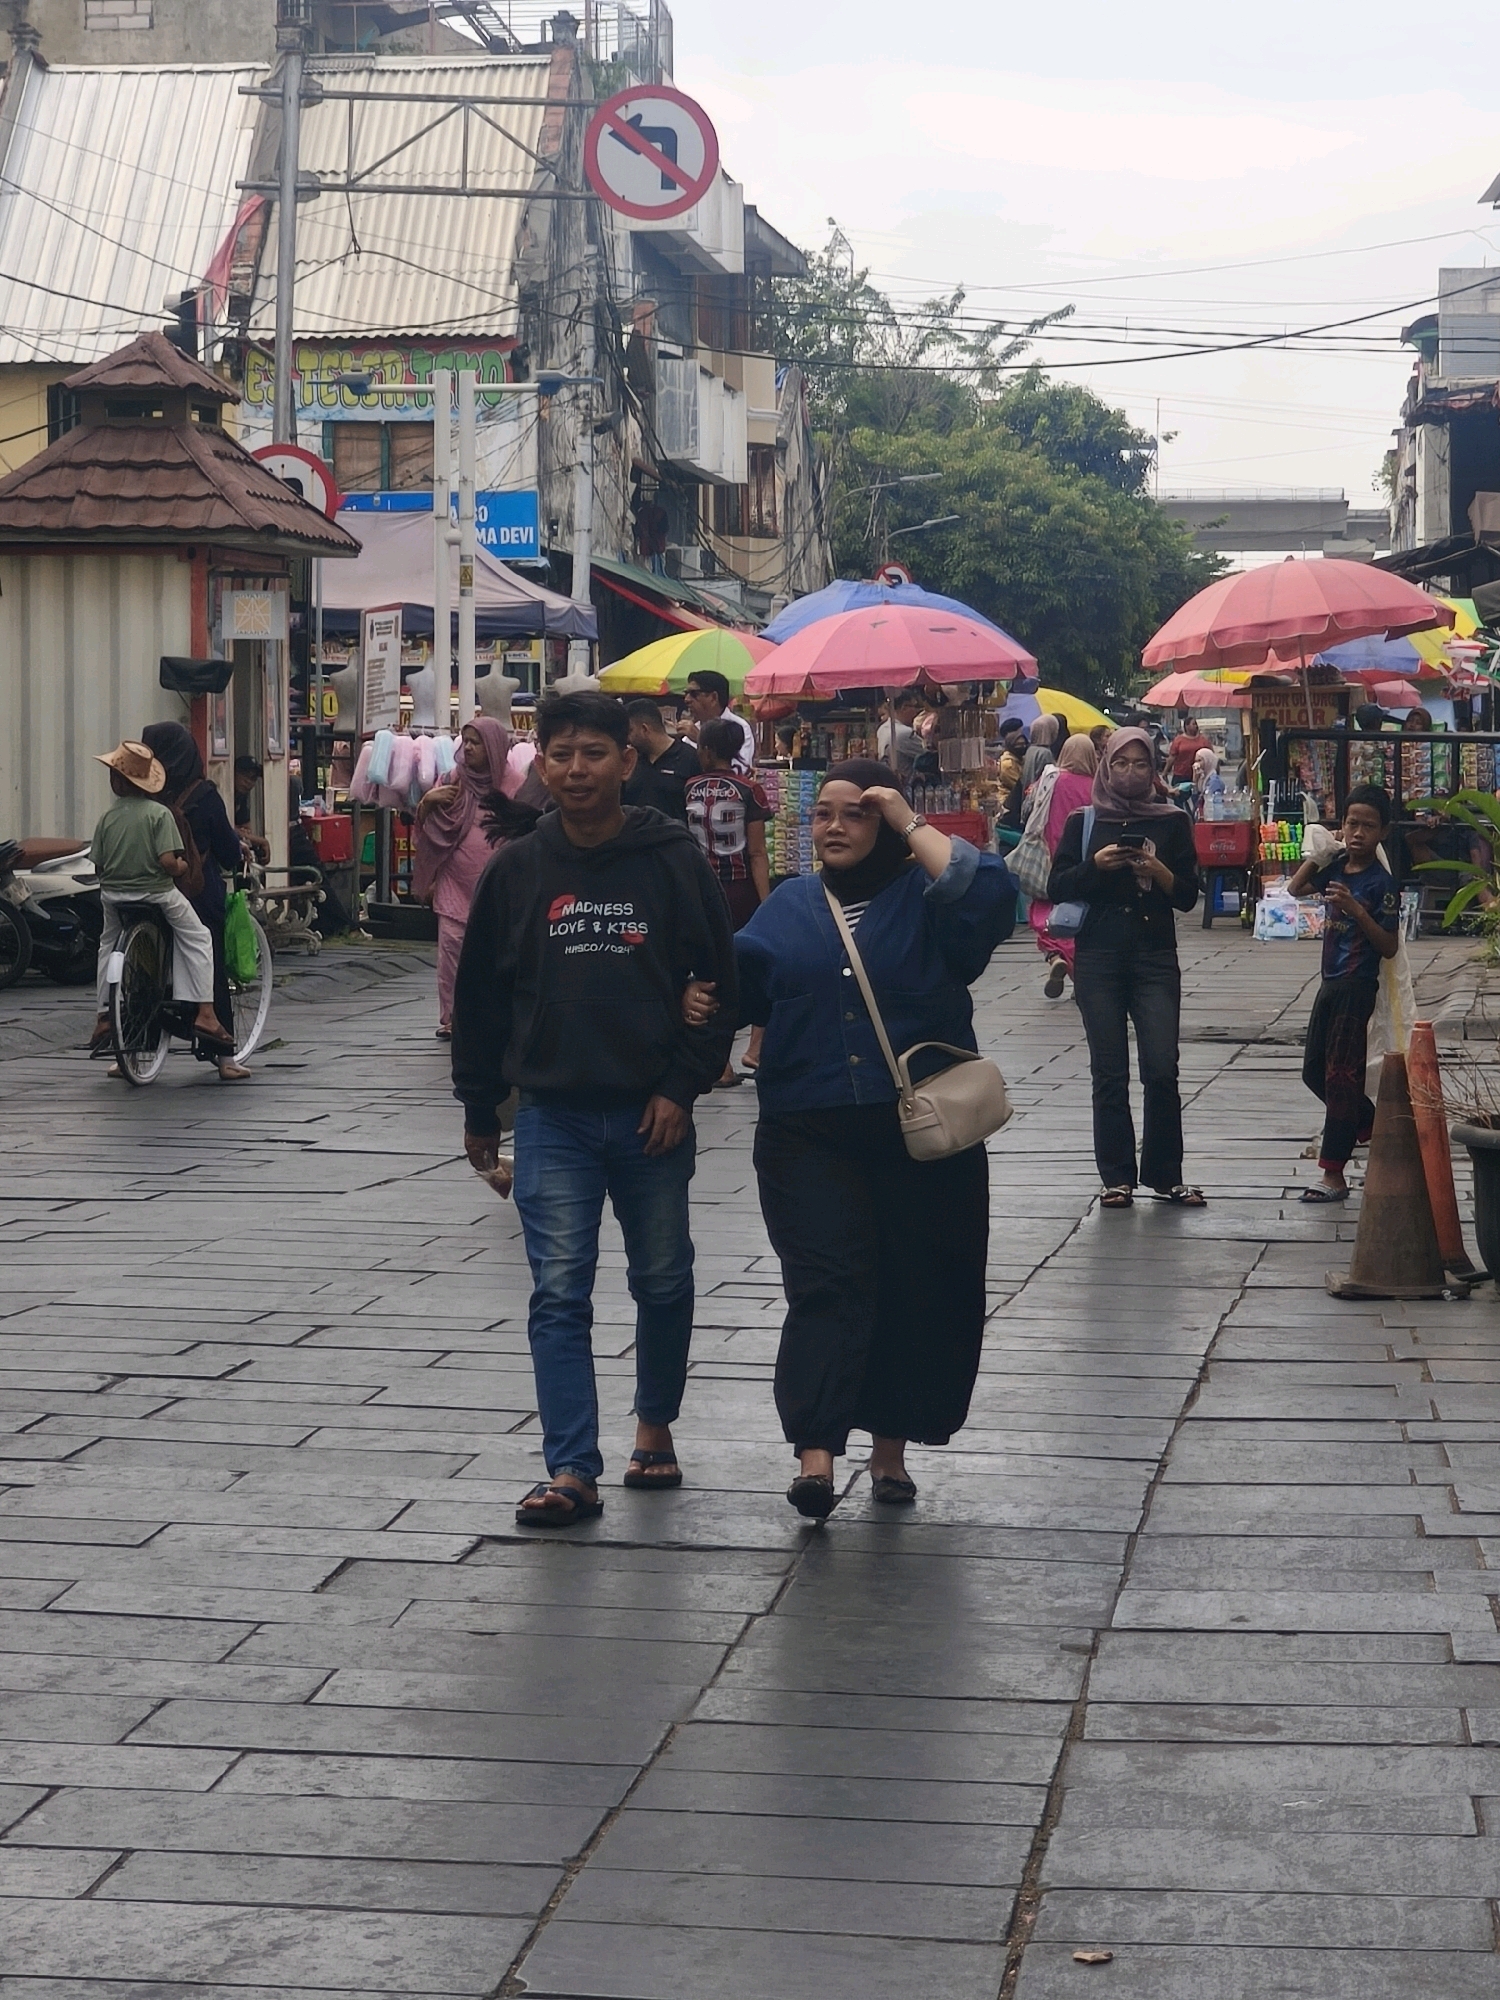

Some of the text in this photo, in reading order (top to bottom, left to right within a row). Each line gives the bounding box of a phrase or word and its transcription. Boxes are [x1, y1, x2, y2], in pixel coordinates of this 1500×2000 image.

[297, 348, 404, 409] TELER
[501, 527, 534, 544] DEVI
[1292, 693, 1337, 707] GUUNG
[562, 901, 634, 917] MADNESS
[549, 919, 586, 937] LOVE
[607, 921, 649, 935] KISS
